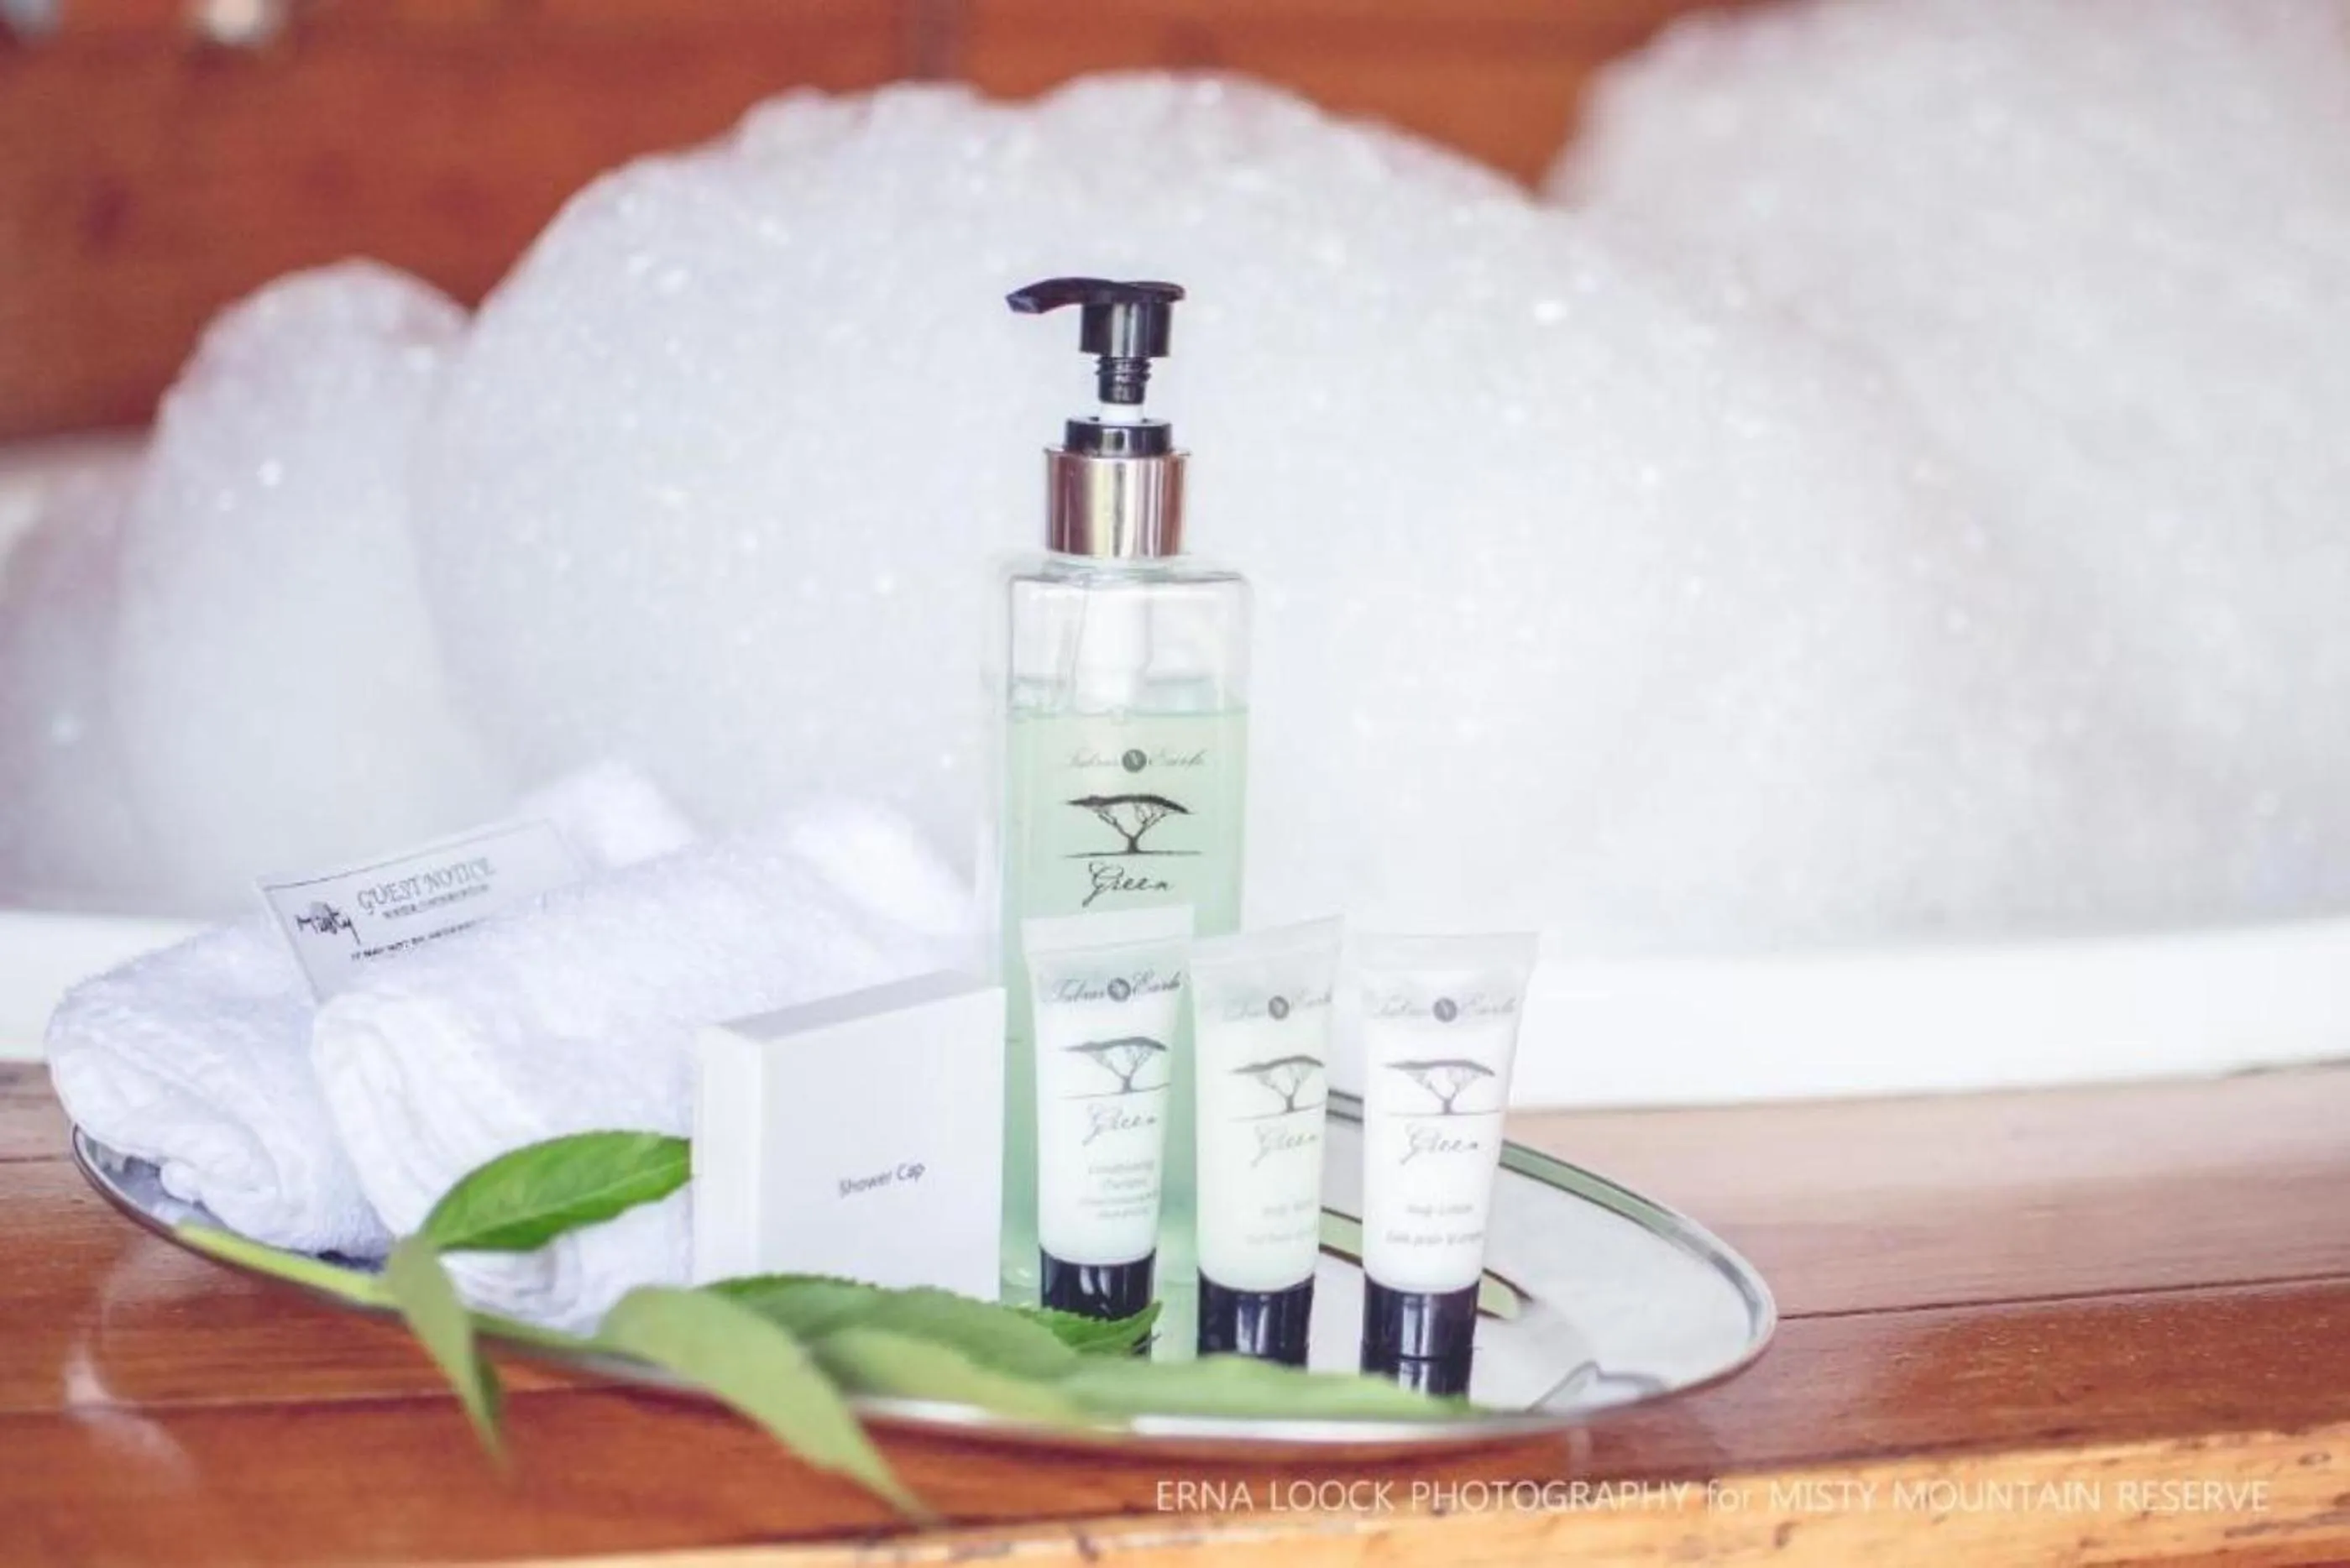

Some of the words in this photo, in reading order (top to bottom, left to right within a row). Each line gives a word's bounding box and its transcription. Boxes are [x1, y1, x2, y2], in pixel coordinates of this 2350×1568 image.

[357, 876, 421, 915] GUEST
[424, 857, 495, 892] NOTICE
[1082, 861, 1170, 907] Green
[295, 902, 361, 945] Misty
[1081, 1103, 1156, 1147] Green
[1400, 1122, 1479, 1165] Green
[1251, 1126, 1318, 1168] Green
[840, 1170, 892, 1199] Shower
[897, 1162, 927, 1183] Cap
